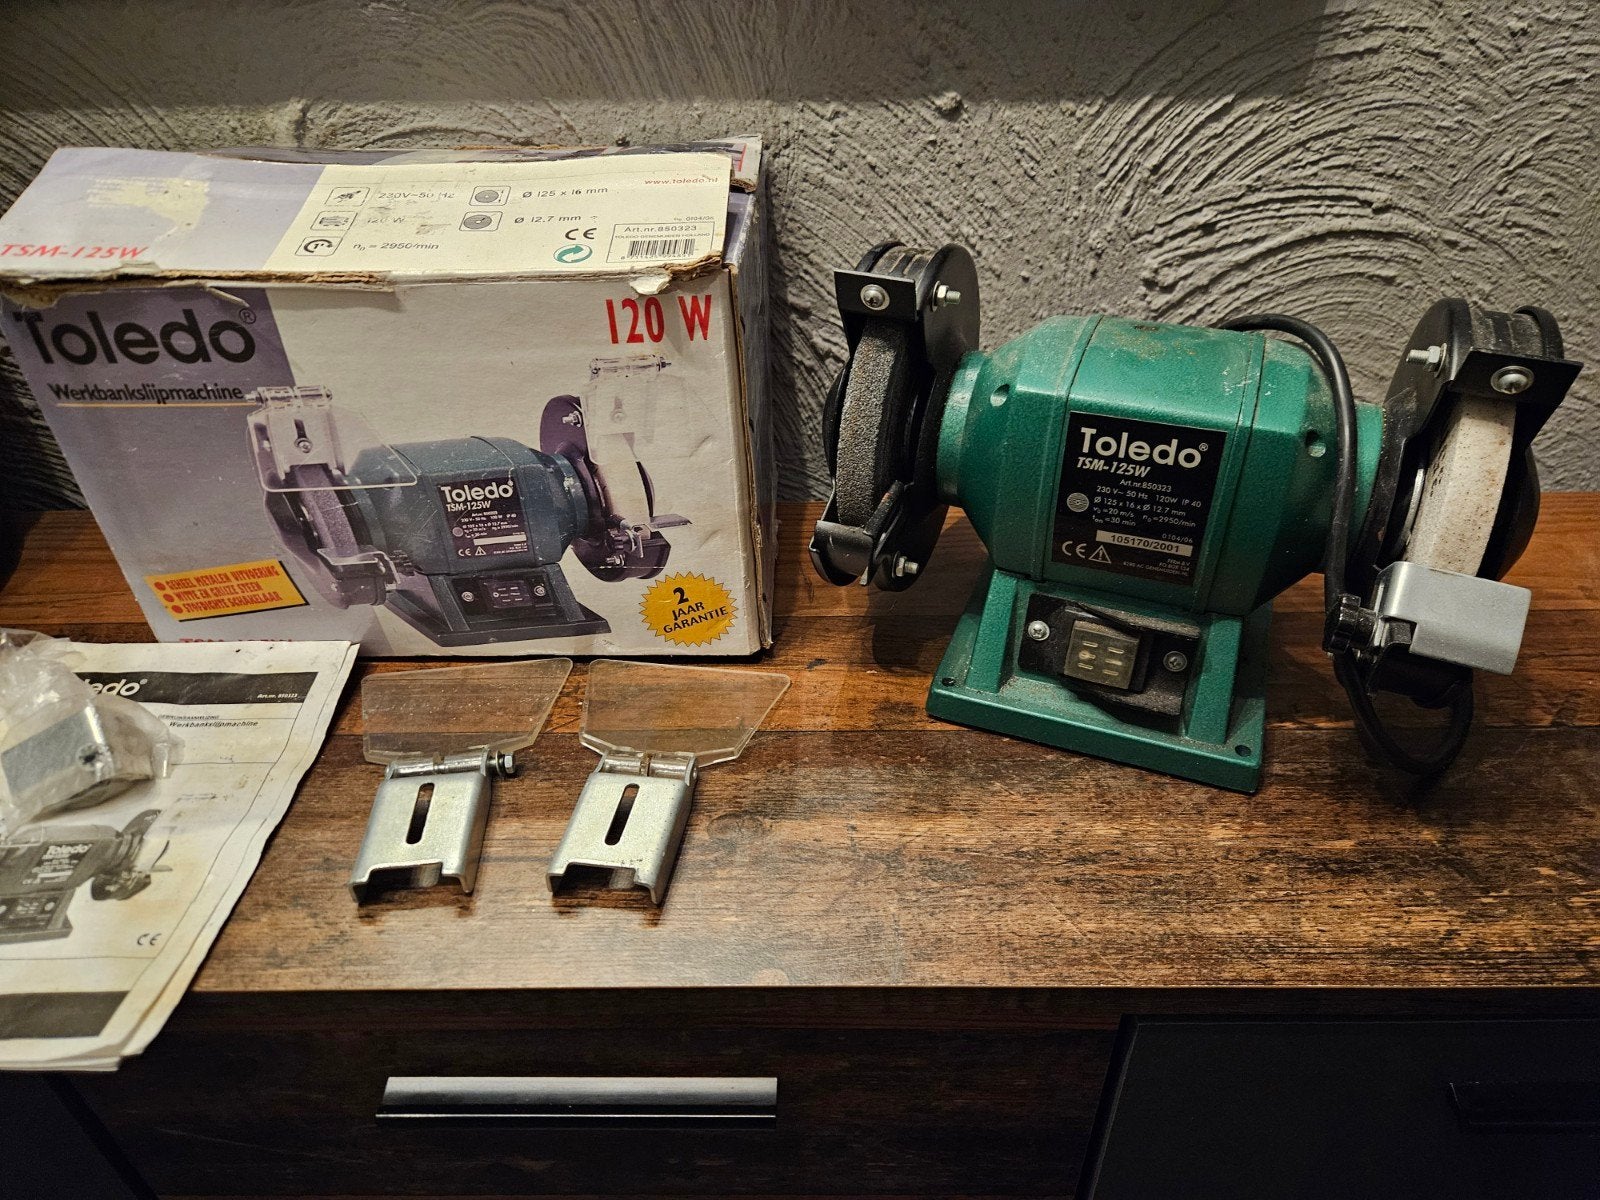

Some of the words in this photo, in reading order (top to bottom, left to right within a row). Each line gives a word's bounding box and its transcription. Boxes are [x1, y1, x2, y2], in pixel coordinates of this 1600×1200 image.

[644, 177, 719, 185] www.toledo.nl
[624, 225, 697, 233] Art.nr.850323
[0, 244, 149, 259] TSM-125W
[380, 242, 440, 250] 2950/min
[605, 297, 665, 344] 120
[677, 295, 712, 341] W
[47, 384, 244, 405] Werkbankslijpmachine
[1076, 457, 1151, 478] TSM-125W
[1120, 479, 1172, 493] Art.nr.850323
[1096, 485, 1111, 494] 230
[1126, 490, 1137, 498] 50
[1138, 492, 1149, 500] Hz
[1181, 498, 1190, 506] IP
[1190, 500, 1202, 508] 40
[446, 501, 491, 512] TSM-125W
[1104, 498, 1117, 506] 125
[1126, 501, 1135, 509] 16
[1153, 505, 1170, 514] 12.7
[1171, 508, 1186, 516] mm
[1119, 509, 1134, 518] m/s
[1121, 519, 1137, 527] min
[1110, 534, 1180, 552] 105170/2001
[1161, 533, 1193, 543] 0104/06
[237, 581, 264, 594] STEEN
[673, 587, 690, 606] 2
[672, 601, 706, 621] JAAR
[663, 605, 729, 634] GARANTIE
